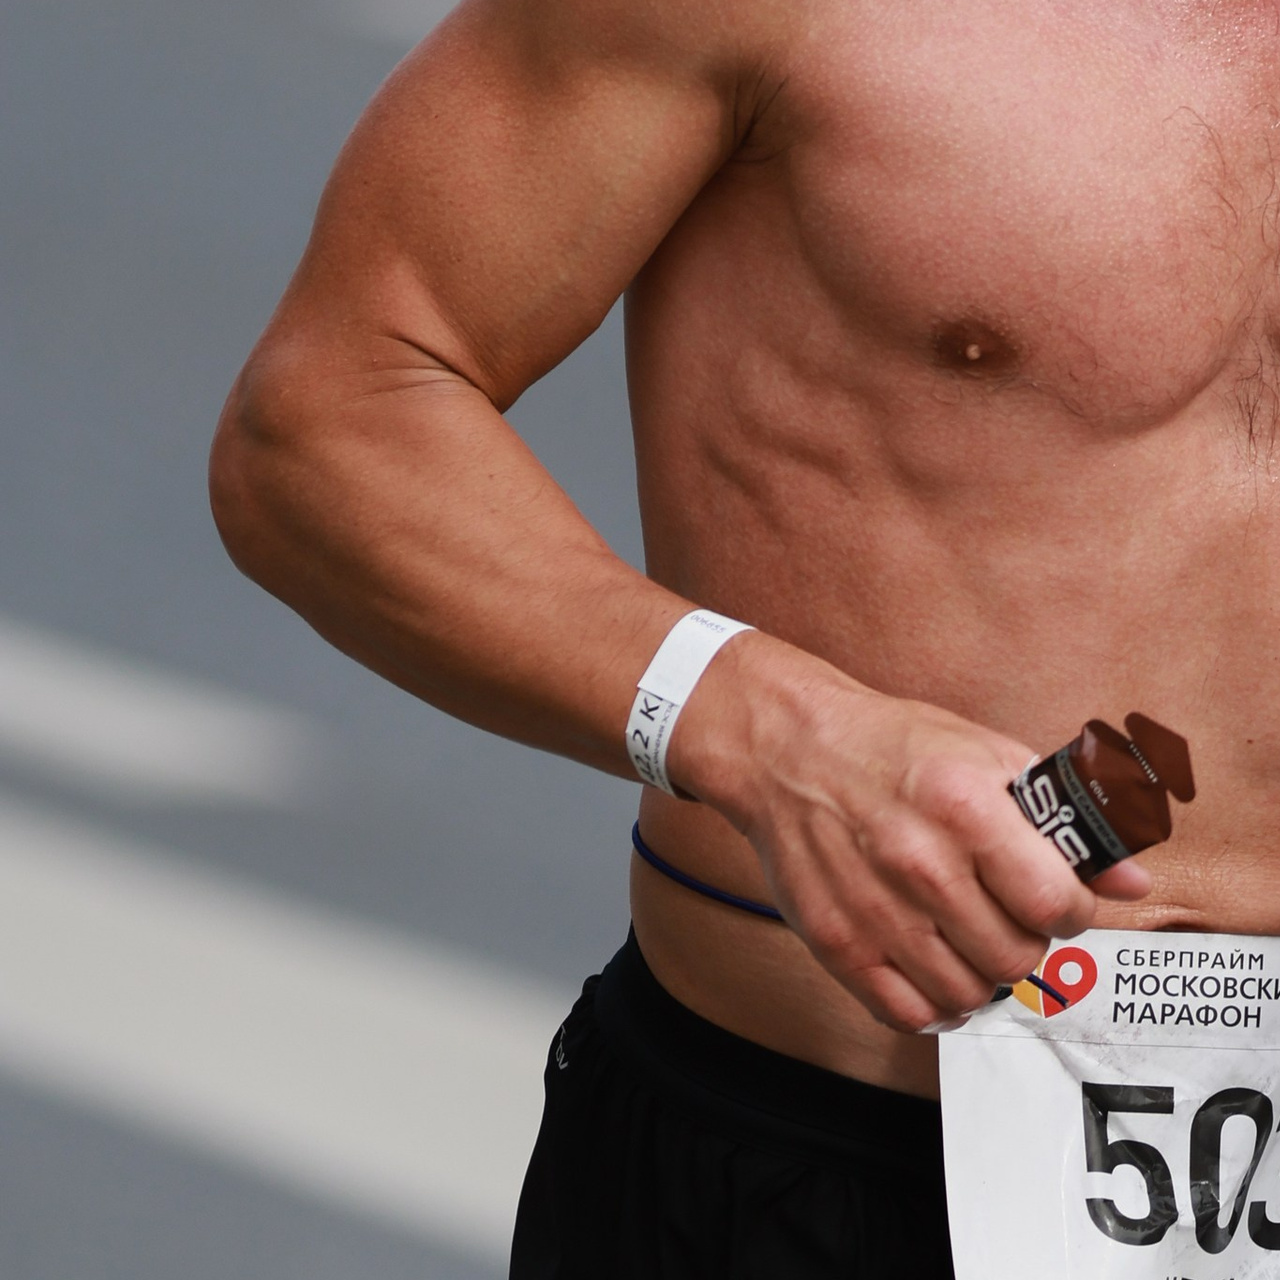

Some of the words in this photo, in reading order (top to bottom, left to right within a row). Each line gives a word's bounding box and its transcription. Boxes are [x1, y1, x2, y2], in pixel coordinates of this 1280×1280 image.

[1089, 780, 1109, 806] COLA
[1116, 948, 1264, 971] СБЕРПРАЙМ
[1112, 1001, 1262, 1028] МАРАФОН
